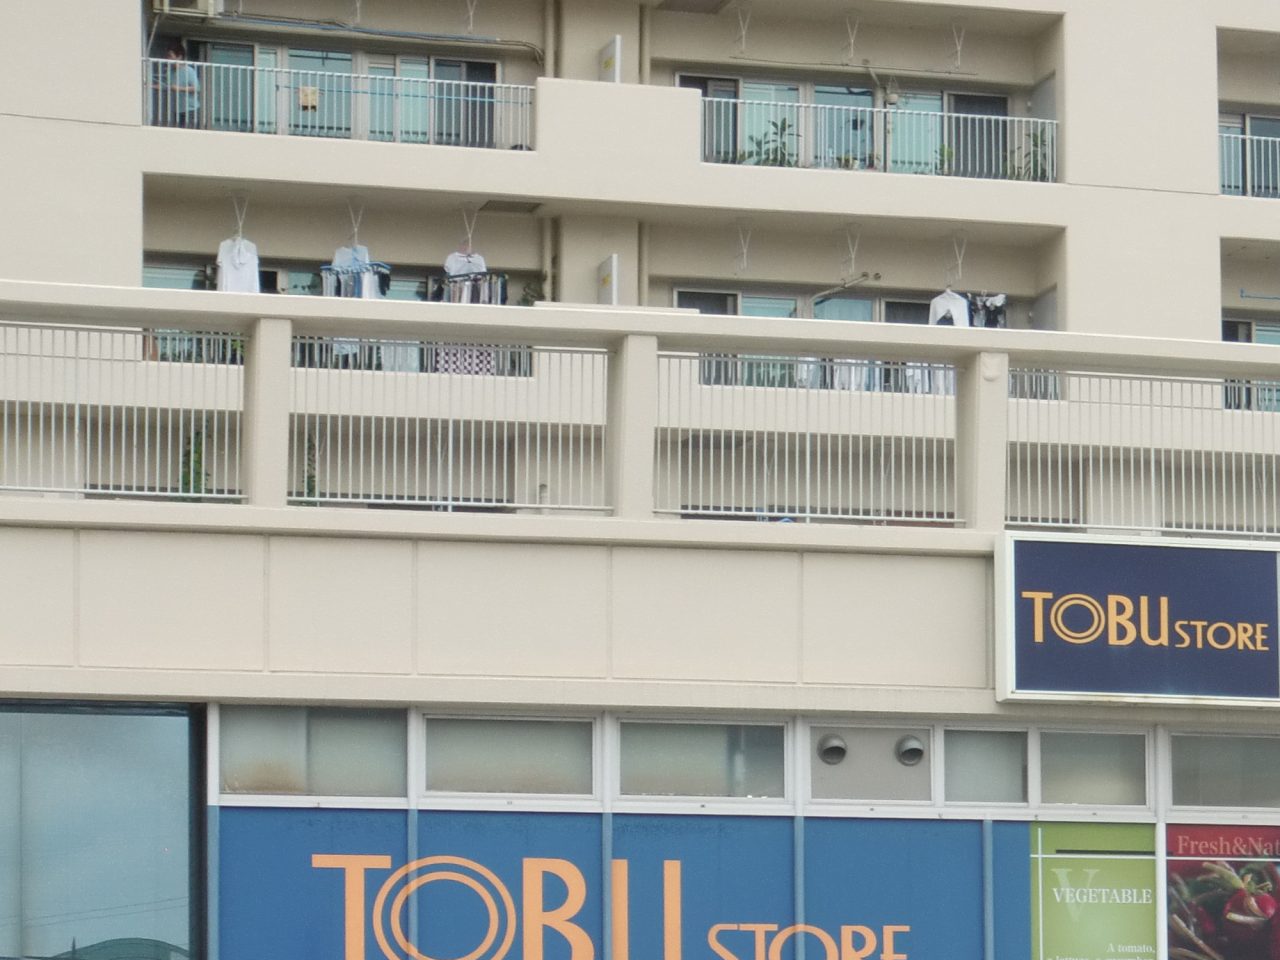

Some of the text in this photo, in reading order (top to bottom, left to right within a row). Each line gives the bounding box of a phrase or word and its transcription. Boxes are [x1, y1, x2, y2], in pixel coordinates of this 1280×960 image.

[1021, 591, 1269, 652] TOBU STORE
[1053, 888, 1152, 904] VEGETABLE
